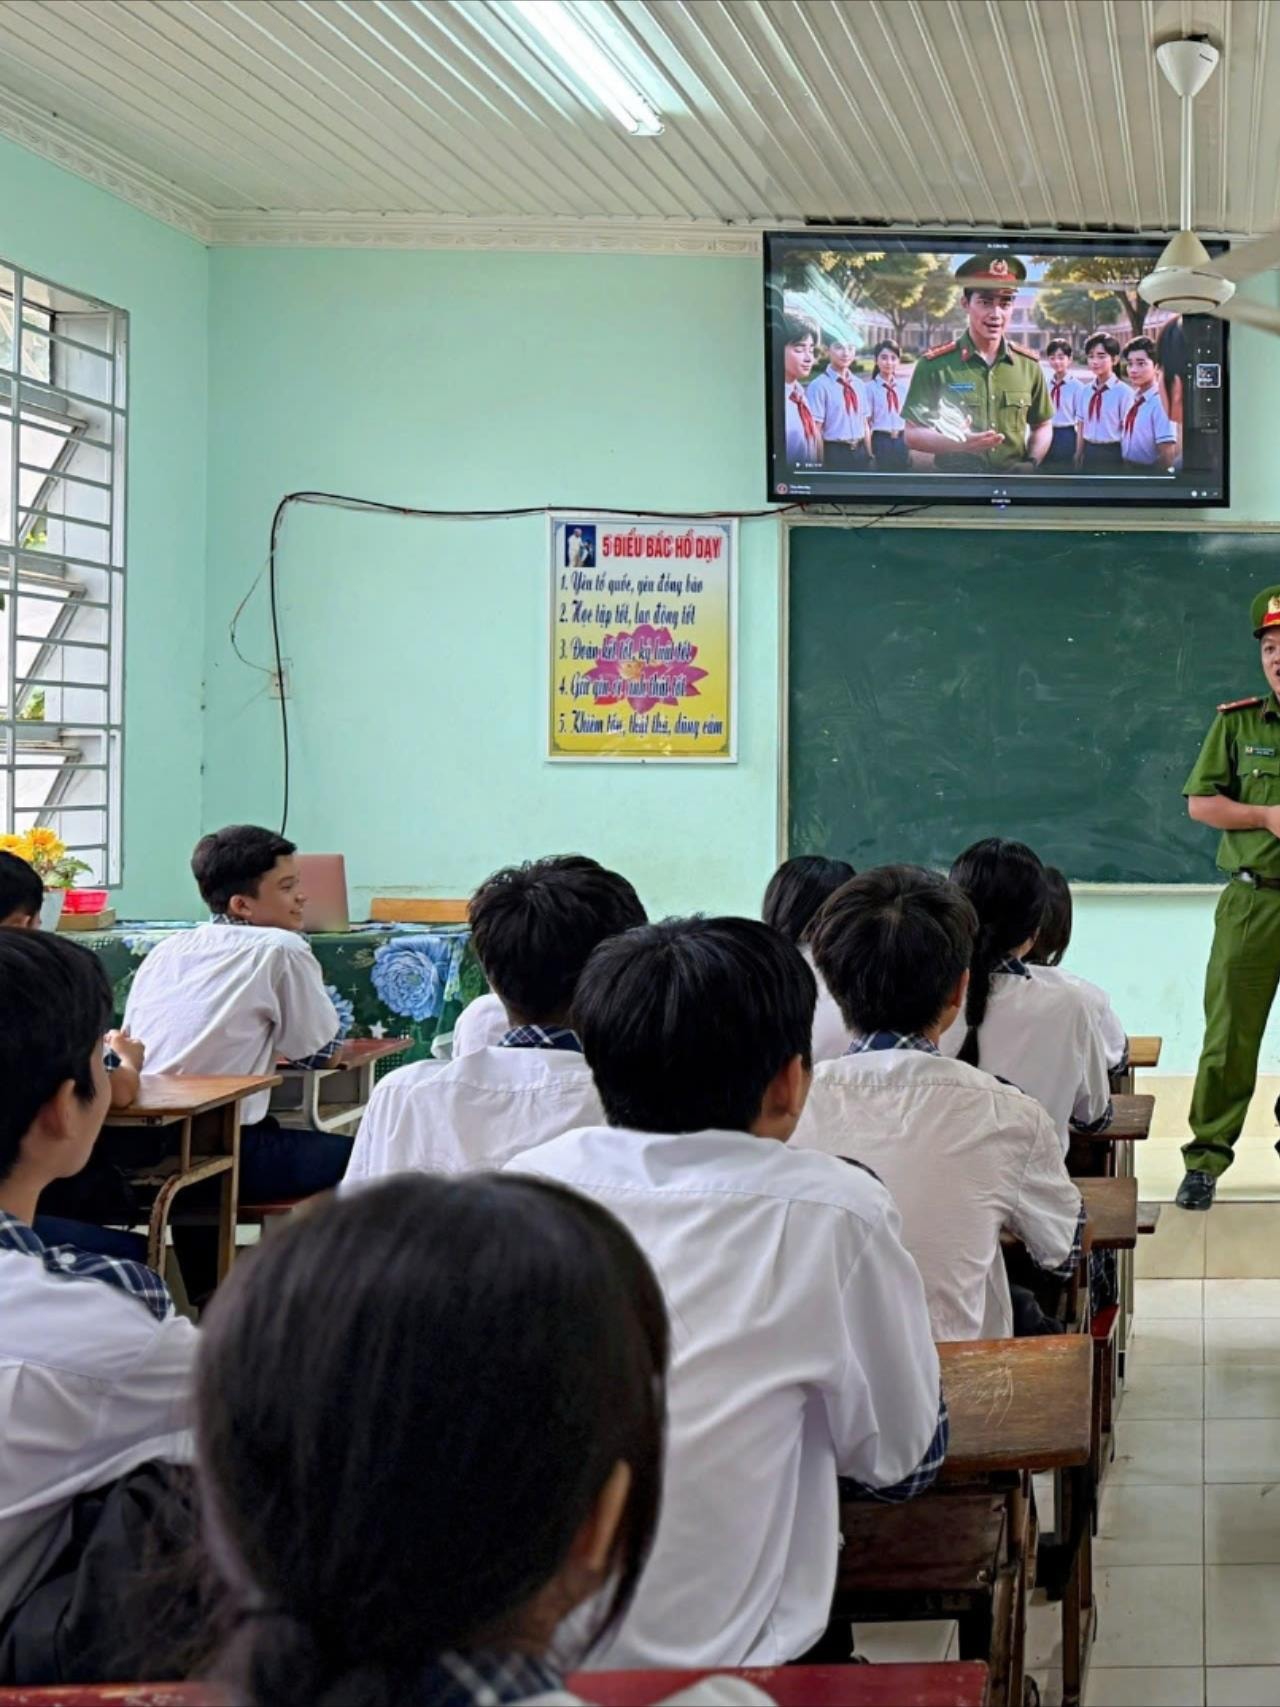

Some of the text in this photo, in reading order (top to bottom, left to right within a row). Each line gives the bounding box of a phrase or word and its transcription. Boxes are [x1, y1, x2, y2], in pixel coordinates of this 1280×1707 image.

[602, 528, 722, 563] 5 ĐIỀU BÁC HỒ DẠY
[561, 574, 568, 590] 1.
[560, 603, 568, 623] 2.
[560, 639, 567, 659] 3.
[559, 676, 567, 695] 4.
[559, 713, 566, 732] 5.
